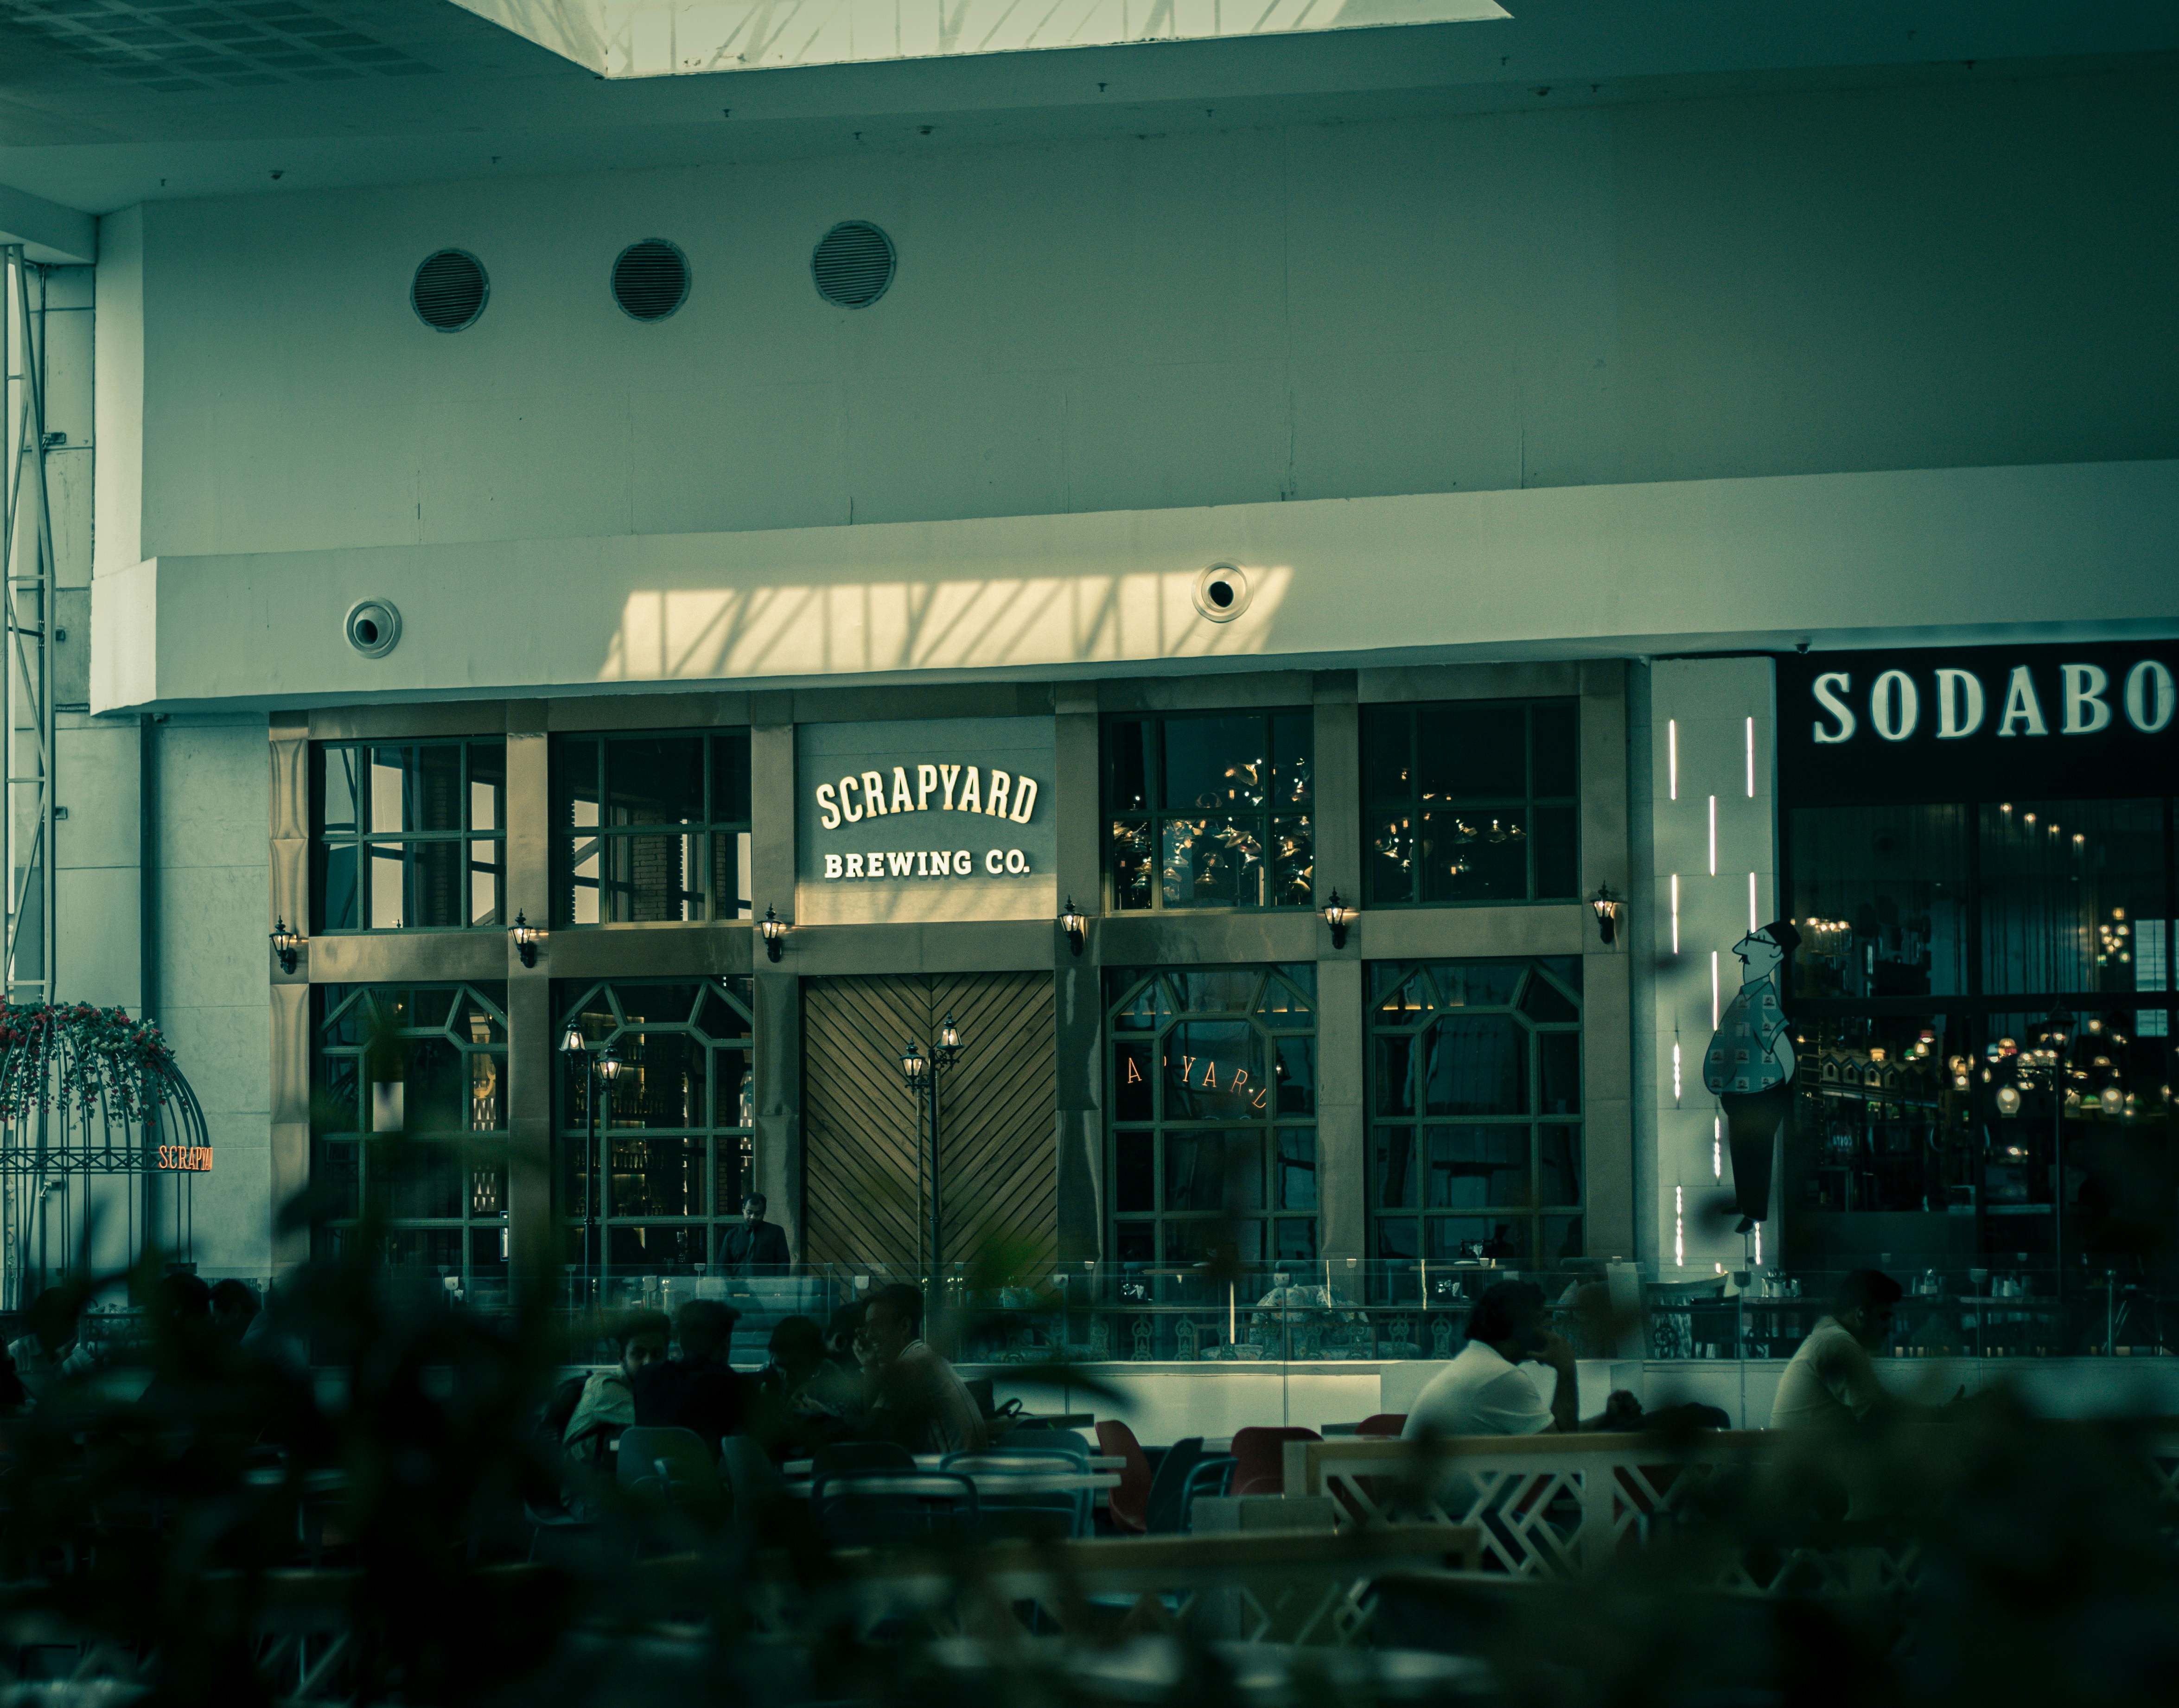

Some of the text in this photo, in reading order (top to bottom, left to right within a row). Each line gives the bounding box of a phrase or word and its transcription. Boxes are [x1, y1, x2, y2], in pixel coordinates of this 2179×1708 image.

[1813, 660, 2175, 743] SODABO
[816, 764, 1038, 830] SCRAPYARD
[824, 849, 1030, 879] BREWING CO.
